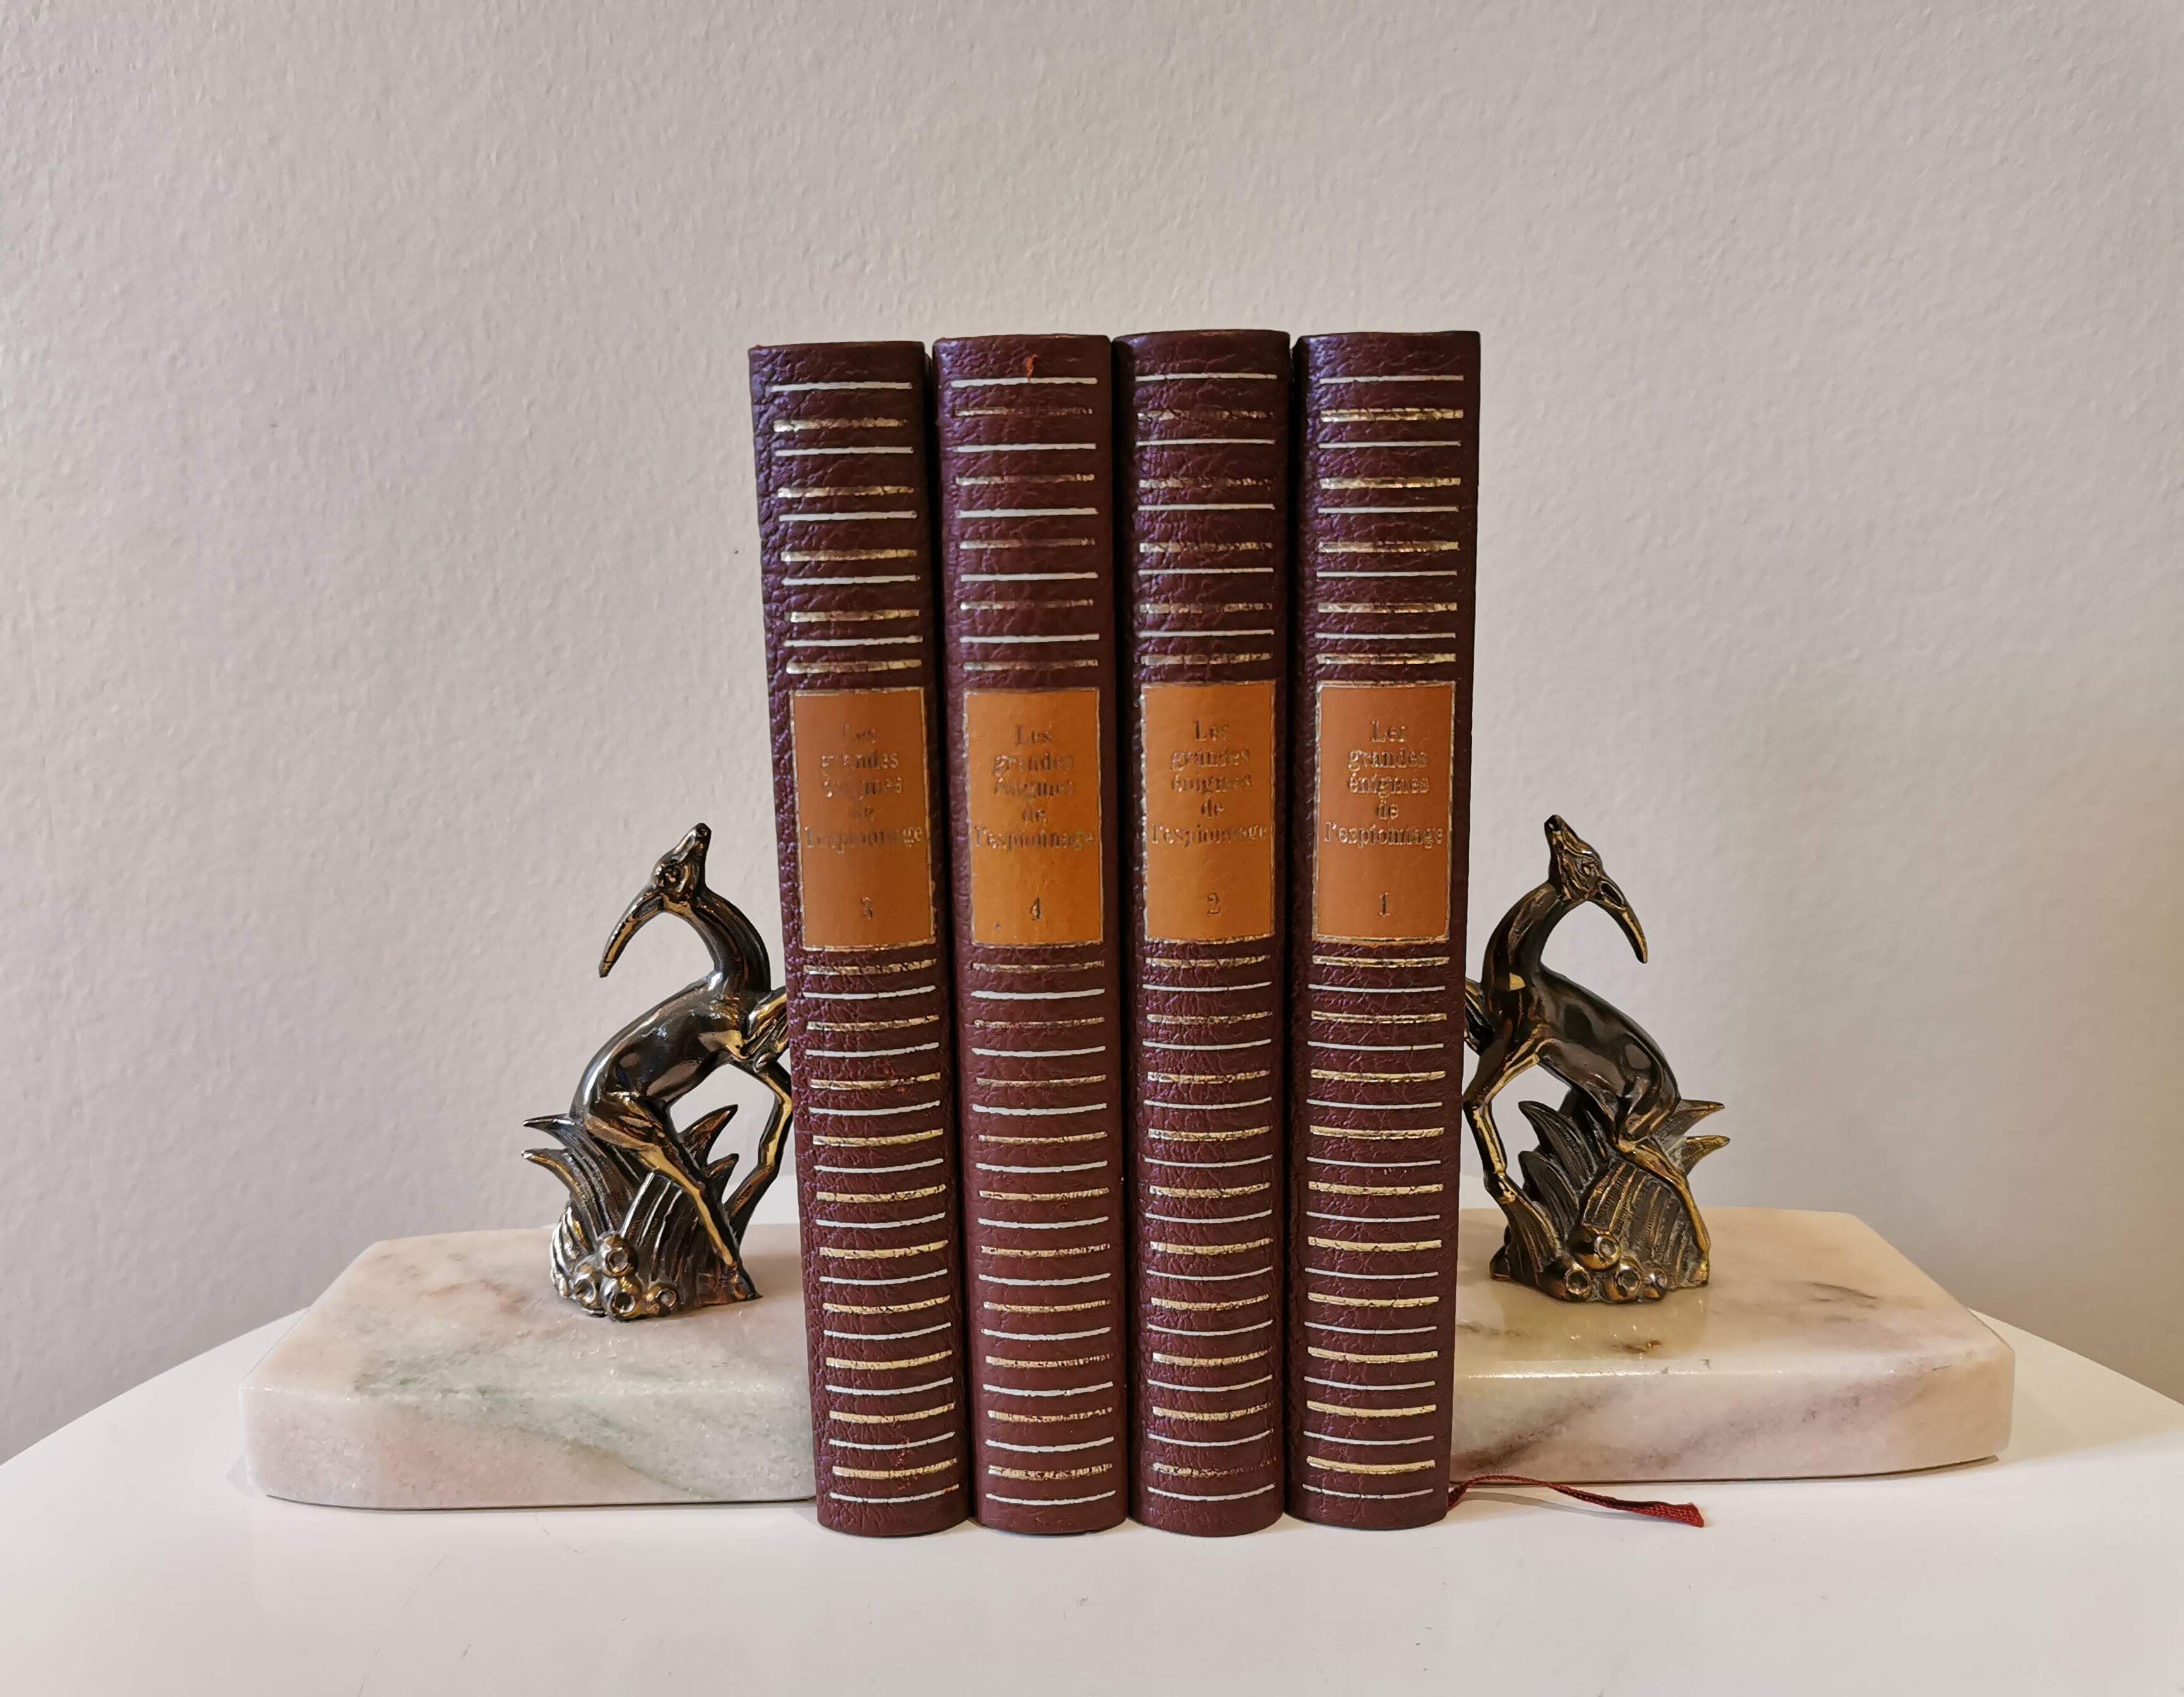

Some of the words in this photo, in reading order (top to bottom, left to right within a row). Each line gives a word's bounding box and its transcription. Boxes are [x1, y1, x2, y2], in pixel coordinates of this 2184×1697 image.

[1014, 724, 1053, 746] Les
[1193, 718, 1230, 742] Les
[1369, 718, 1407, 743] Les
[1347, 747, 1428, 772] grandes
[1347, 771, 1430, 799] énigmes
[1021, 802, 1048, 823] de
[1200, 797, 1225, 819] de
[1376, 799, 1400, 821] de
[1323, 821, 1445, 849] l'espionnage
[1029, 896, 1041, 922] 4
[1205, 891, 1222, 916] 2
[1376, 891, 1392, 917] 1
